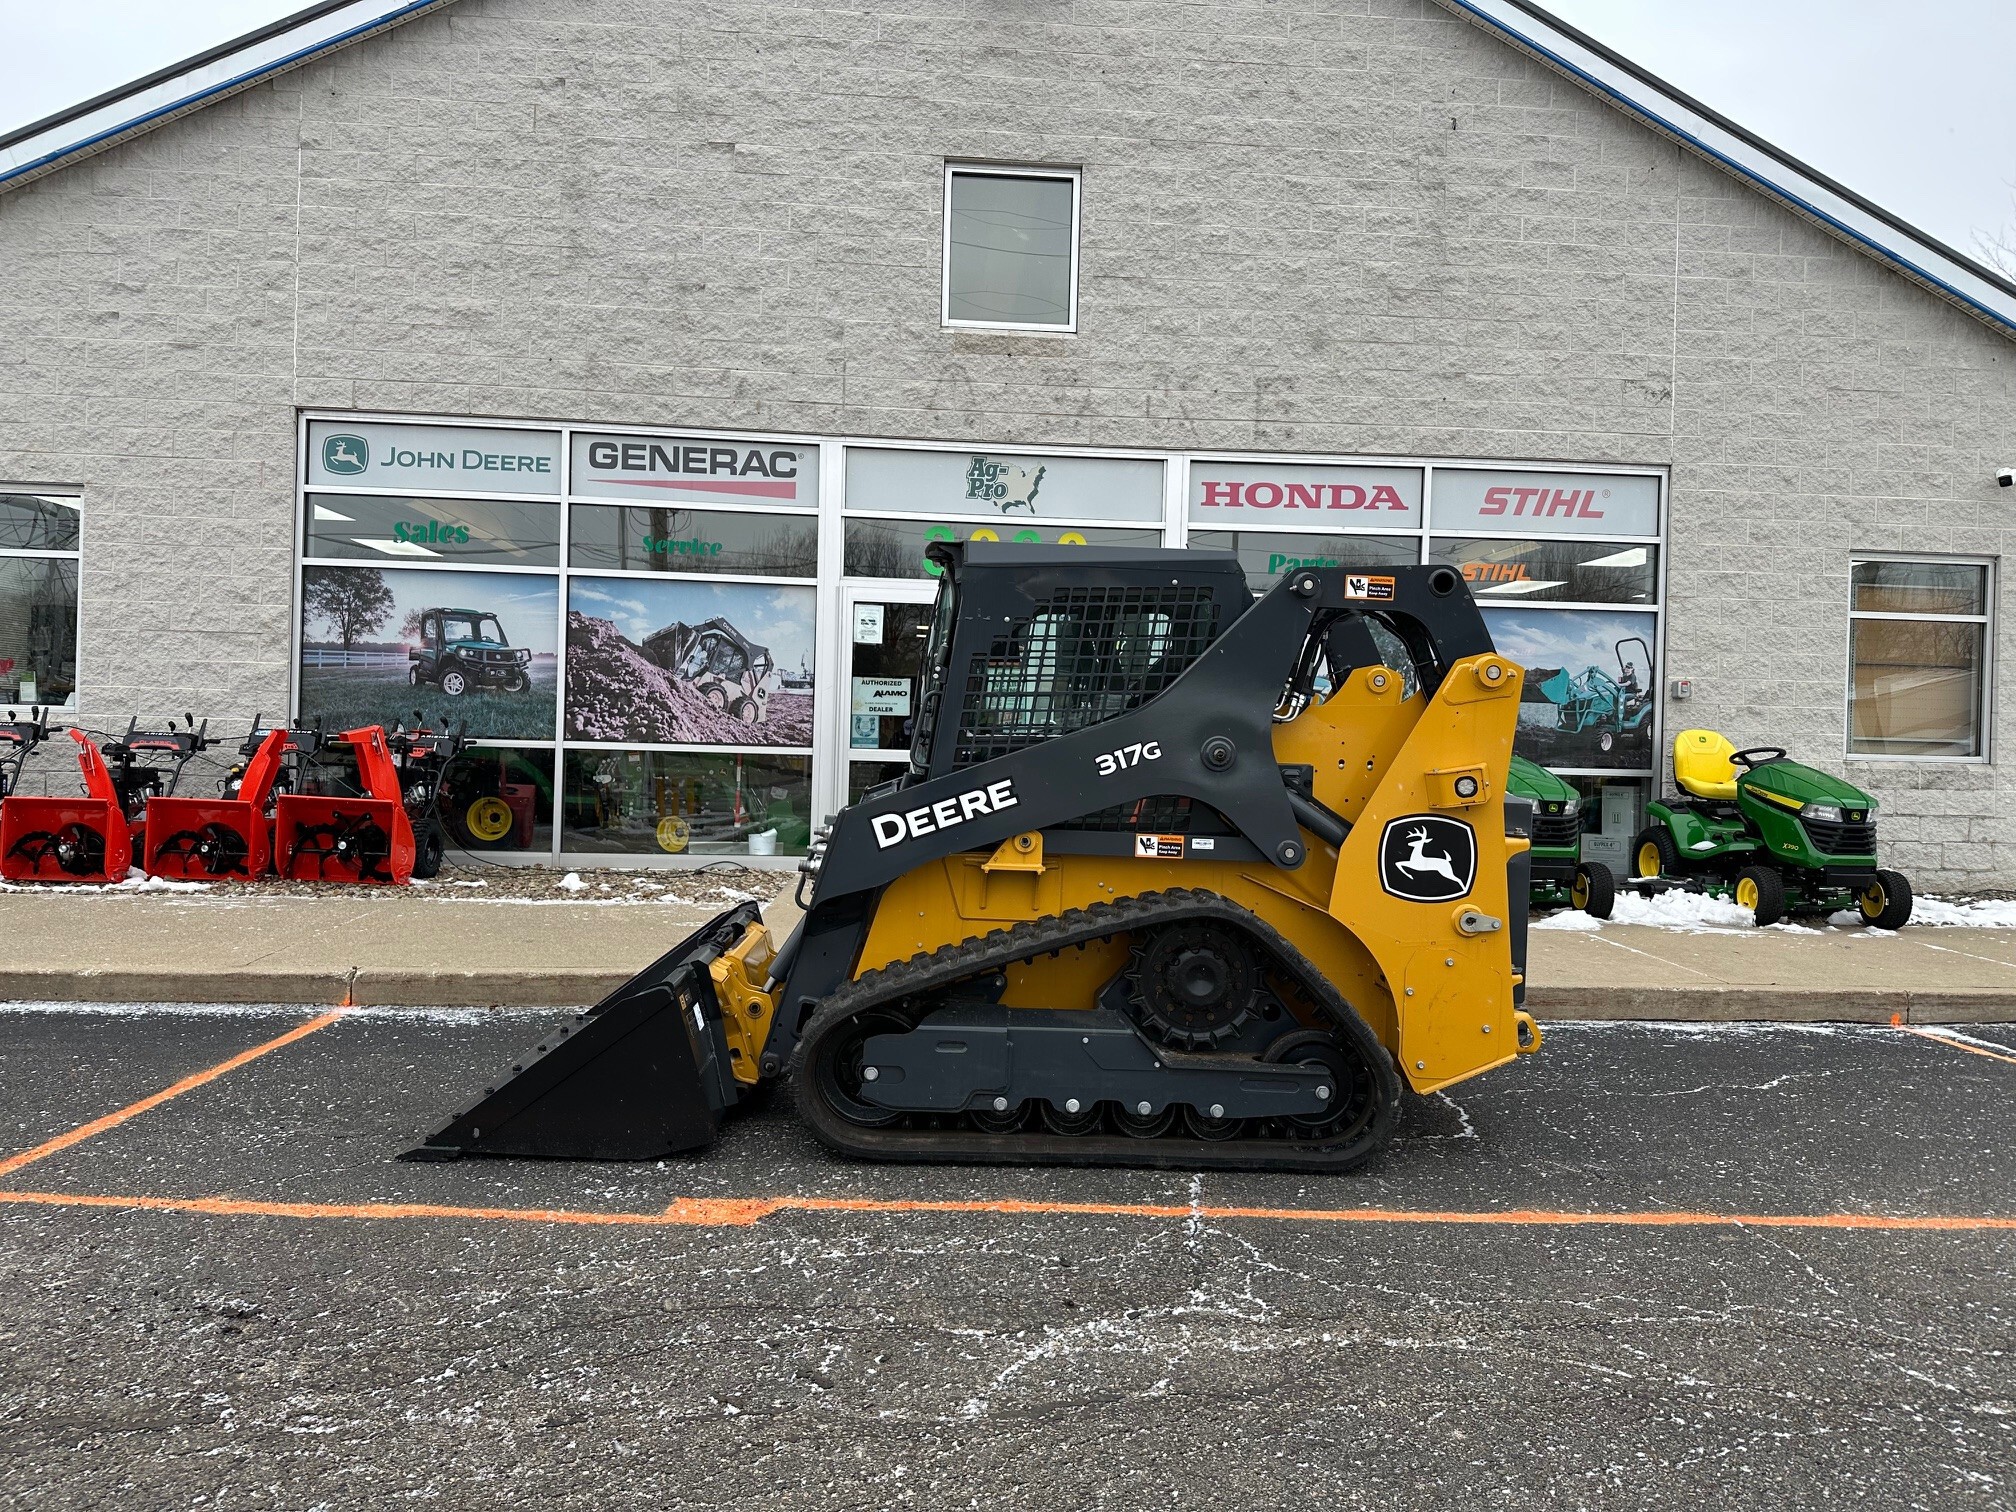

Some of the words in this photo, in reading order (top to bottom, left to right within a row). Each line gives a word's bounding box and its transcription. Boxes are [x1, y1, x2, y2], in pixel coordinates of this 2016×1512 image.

[380, 446, 455, 470] JOHN
[462, 450, 551, 474] DEERE
[966, 478, 1008, 499] Pro
[1200, 481, 1409, 511] HONDA
[393, 520, 470, 545] Sales
[641, 535, 723, 557] Service
[1462, 563, 1532, 582] STIHL
[873, 690, 908, 698] ALAMO
[1095, 741, 1162, 776] 317G
[871, 779, 1018, 849] DEERE
